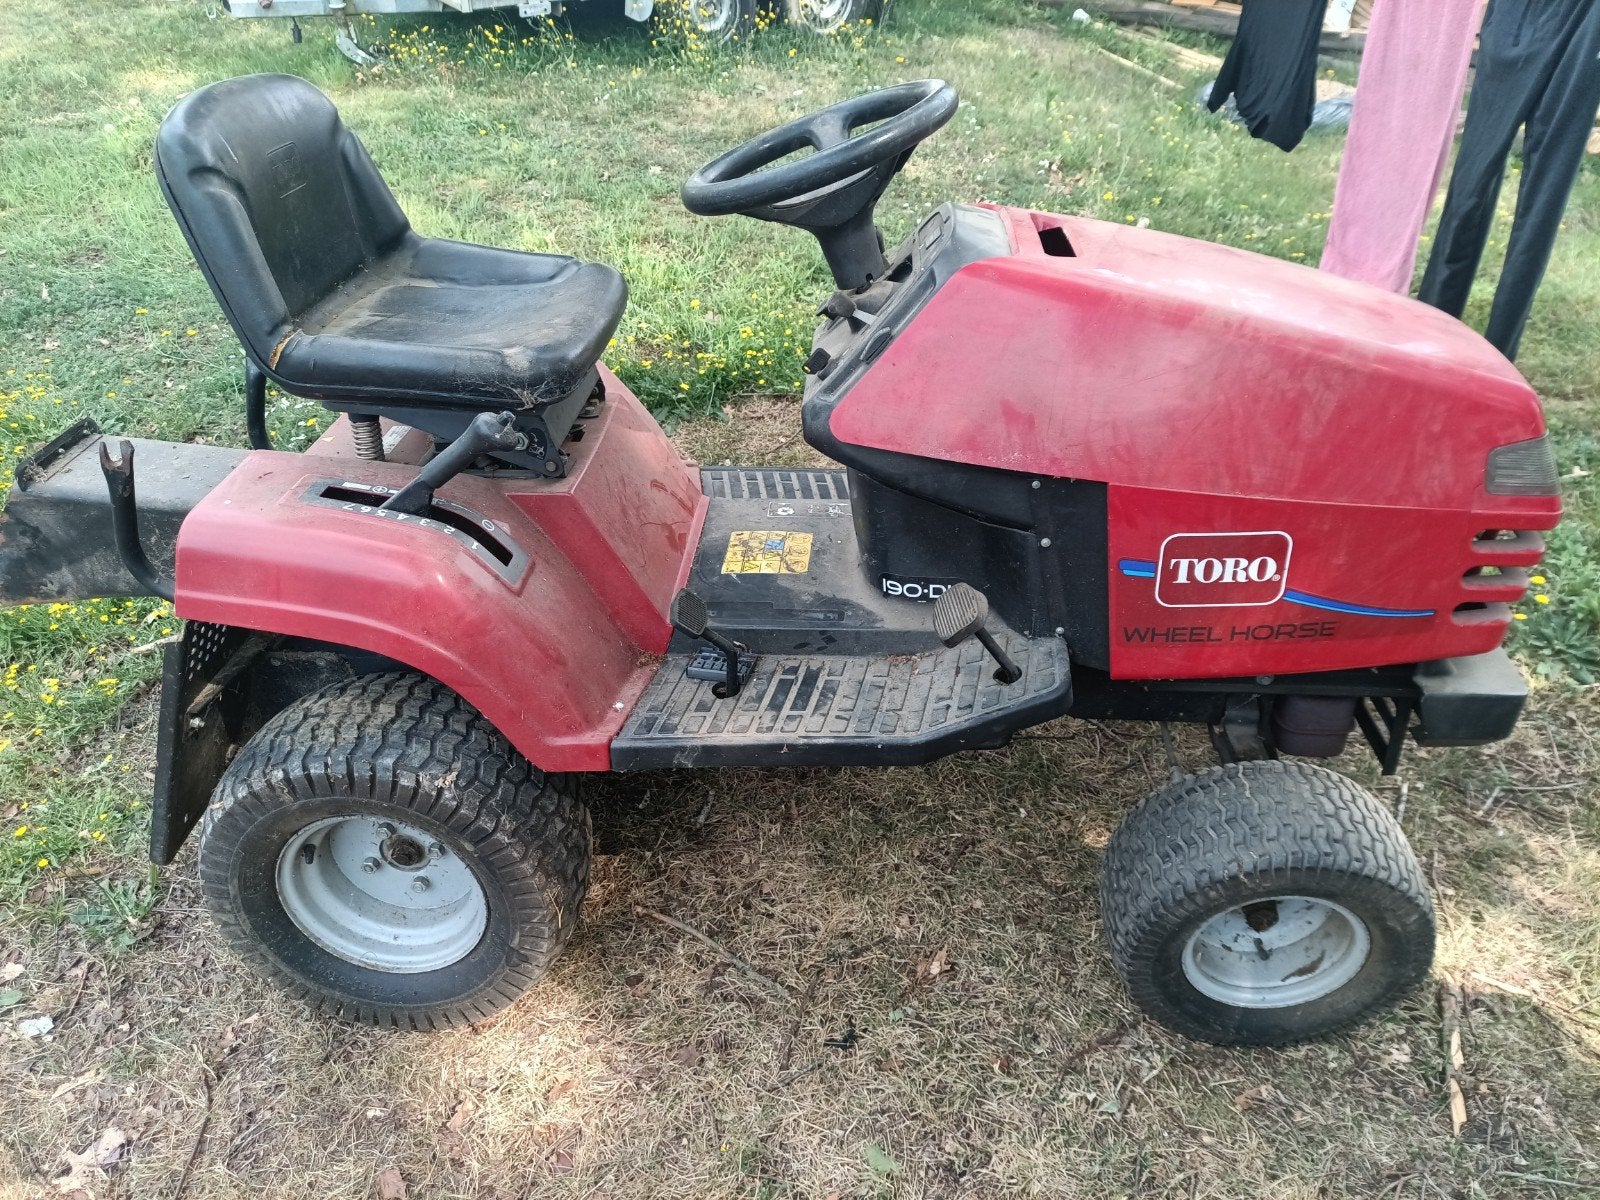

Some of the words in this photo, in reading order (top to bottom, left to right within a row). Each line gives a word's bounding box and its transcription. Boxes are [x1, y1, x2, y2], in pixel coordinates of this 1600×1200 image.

[376, 509, 388, 517] 5
[419, 518, 431, 526] 3
[443, 525, 456, 534] 2
[471, 541, 479, 550] 1
[1123, 626, 1222, 643] WHEEL
[1230, 622, 1338, 640] HORSE
